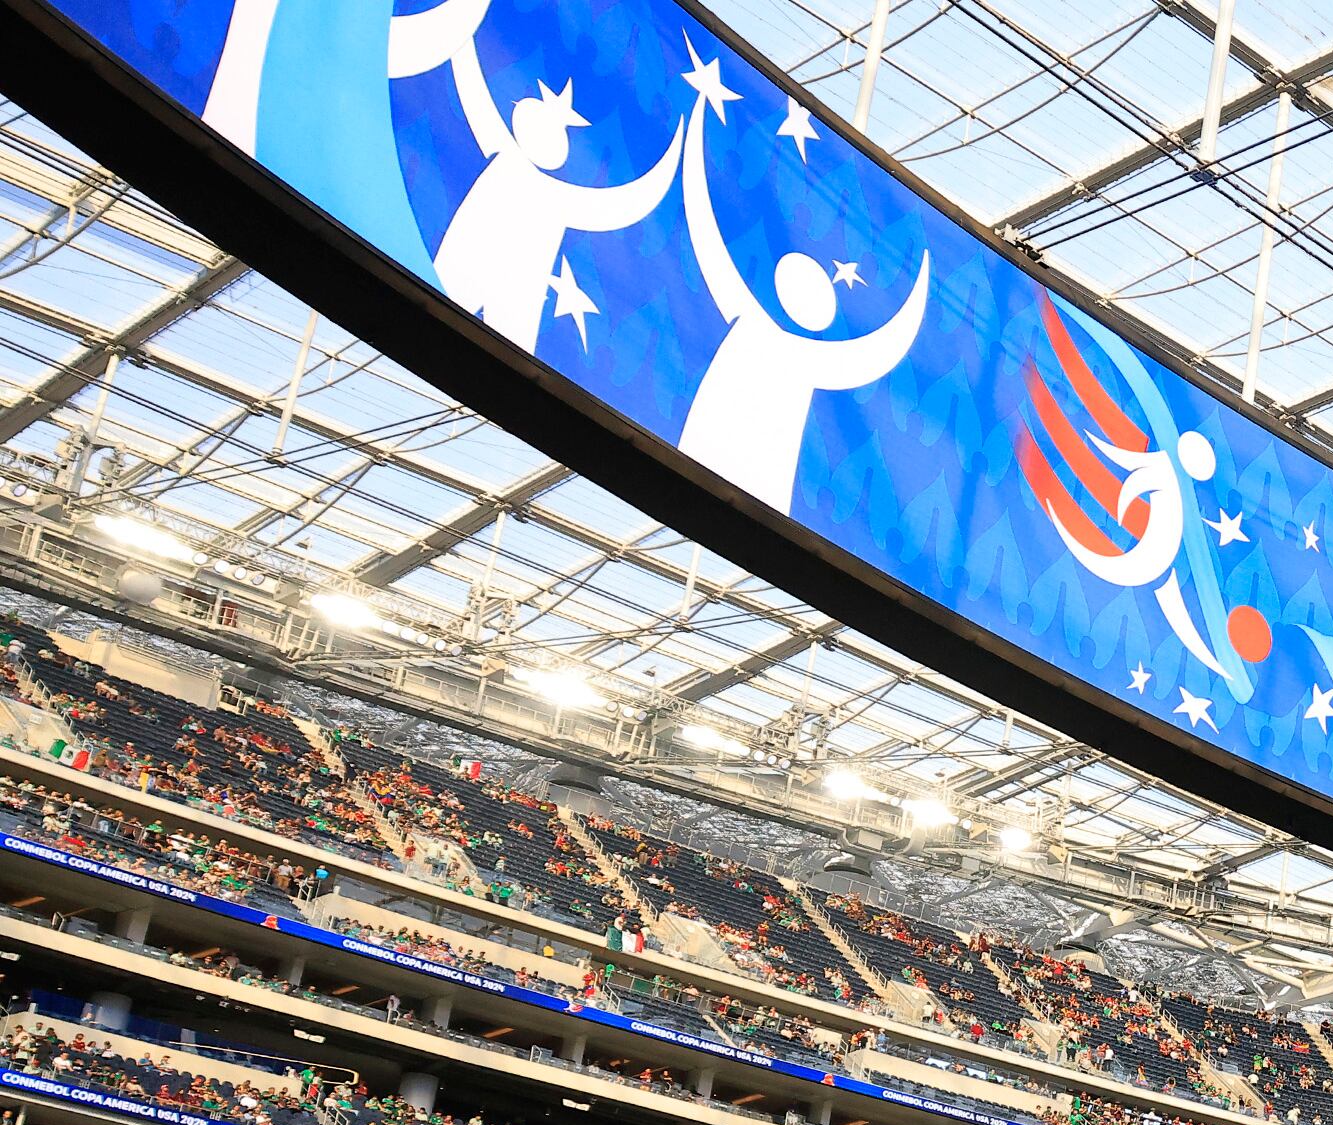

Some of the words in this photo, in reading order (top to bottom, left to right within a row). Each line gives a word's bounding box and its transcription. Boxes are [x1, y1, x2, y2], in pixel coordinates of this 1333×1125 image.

[4, 837, 68, 864] CONMEBOL
[68, 856, 99, 873] COPA
[98, 866, 147, 888] AMERICA
[148, 881, 169, 895] USA
[169, 887, 196, 902] 2024
[1, 1072, 71, 1097] CONMEBOL
[70, 1089, 103, 1105] COPA
[102, 1096, 156, 1118] AMERICA
[157, 1109, 180, 1123] USA
